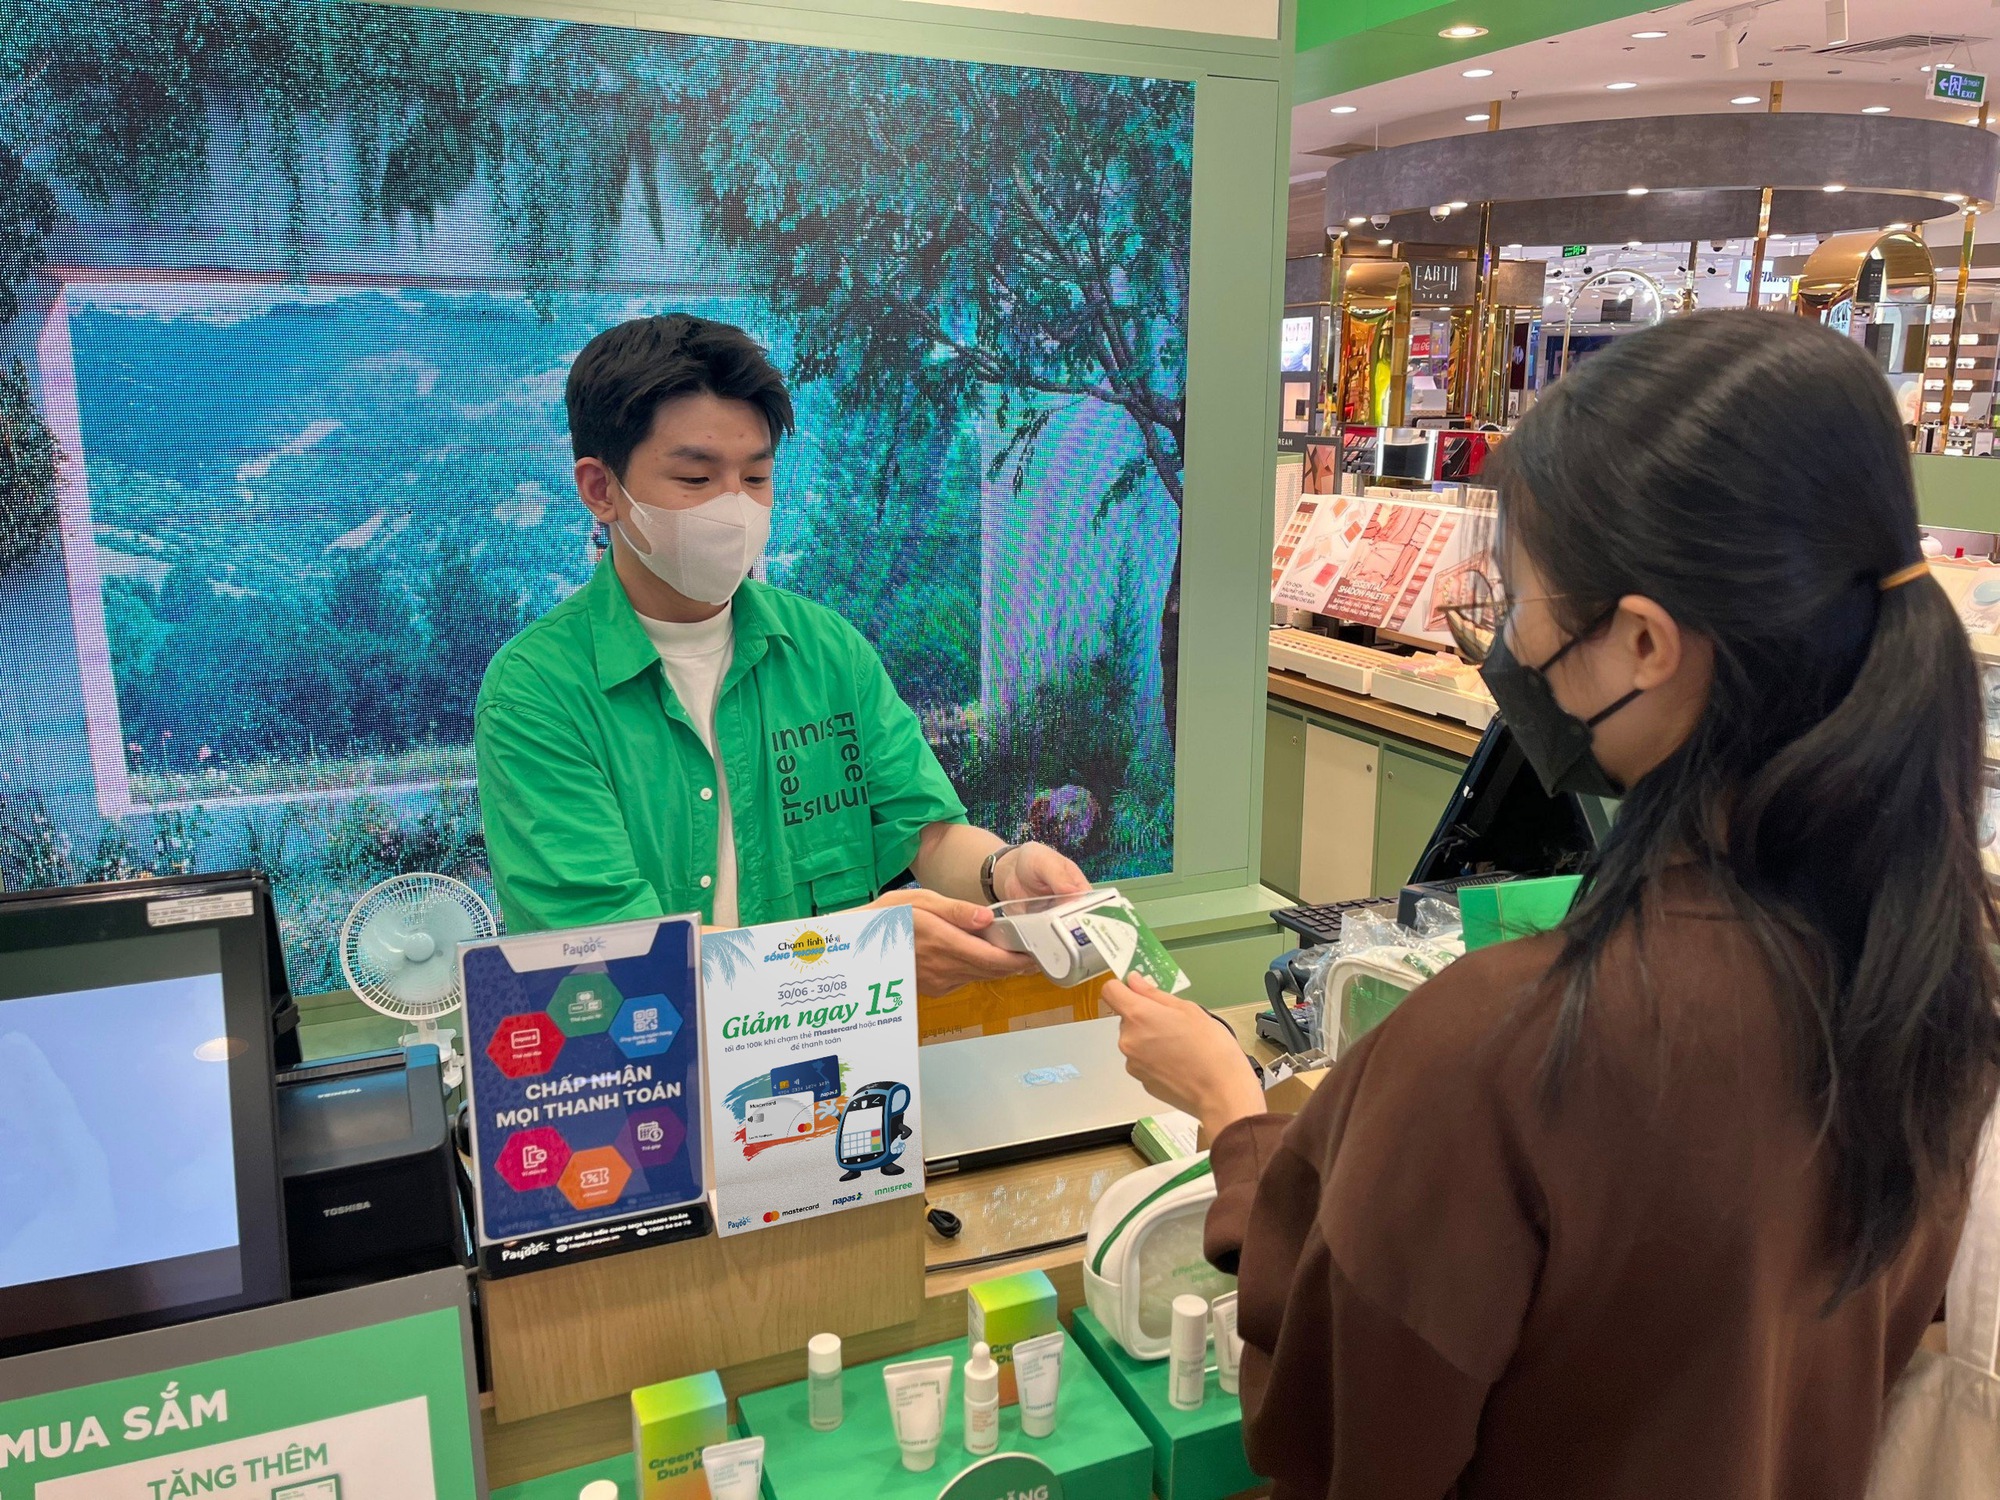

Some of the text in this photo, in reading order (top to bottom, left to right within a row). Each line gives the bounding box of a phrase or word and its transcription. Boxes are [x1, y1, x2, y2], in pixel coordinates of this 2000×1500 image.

[1961, 90, 1977, 99] EXIT
[1338, 585, 1391, 602] SHADOW PALETTE
[563, 941, 598, 957] Payoo
[763, 942, 851, 963] SỐNG PHONG CÁCH
[777, 985, 809, 1000] 30/06
[817, 981, 848, 997] 30/08
[722, 1011, 791, 1039] Giảm
[797, 1001, 859, 1029] ngay
[735, 1043, 745, 1051] đa
[764, 1038, 776, 1046] khi
[777, 1036, 799, 1044] chạm
[858, 1020, 877, 1030] hoặc
[801, 1038, 823, 1049] thanh
[825, 1036, 842, 1045] toán
[525, 1064, 653, 1100] CHẤP NHẬN
[496, 1081, 682, 1128] MỌI THANH TOÁN
[323, 1200, 371, 1217] TOSHIBA
[832, 1193, 856, 1206] napas
[728, 1203, 820, 1230] Payoo mastercard
[502, 1246, 539, 1262] Payoo
[0, 1381, 228, 1469] MUA SẮM
[648, 1451, 694, 1470] Green
[147, 1442, 328, 1500] TĂNG THÊM
[657, 1466, 689, 1481] Duo
